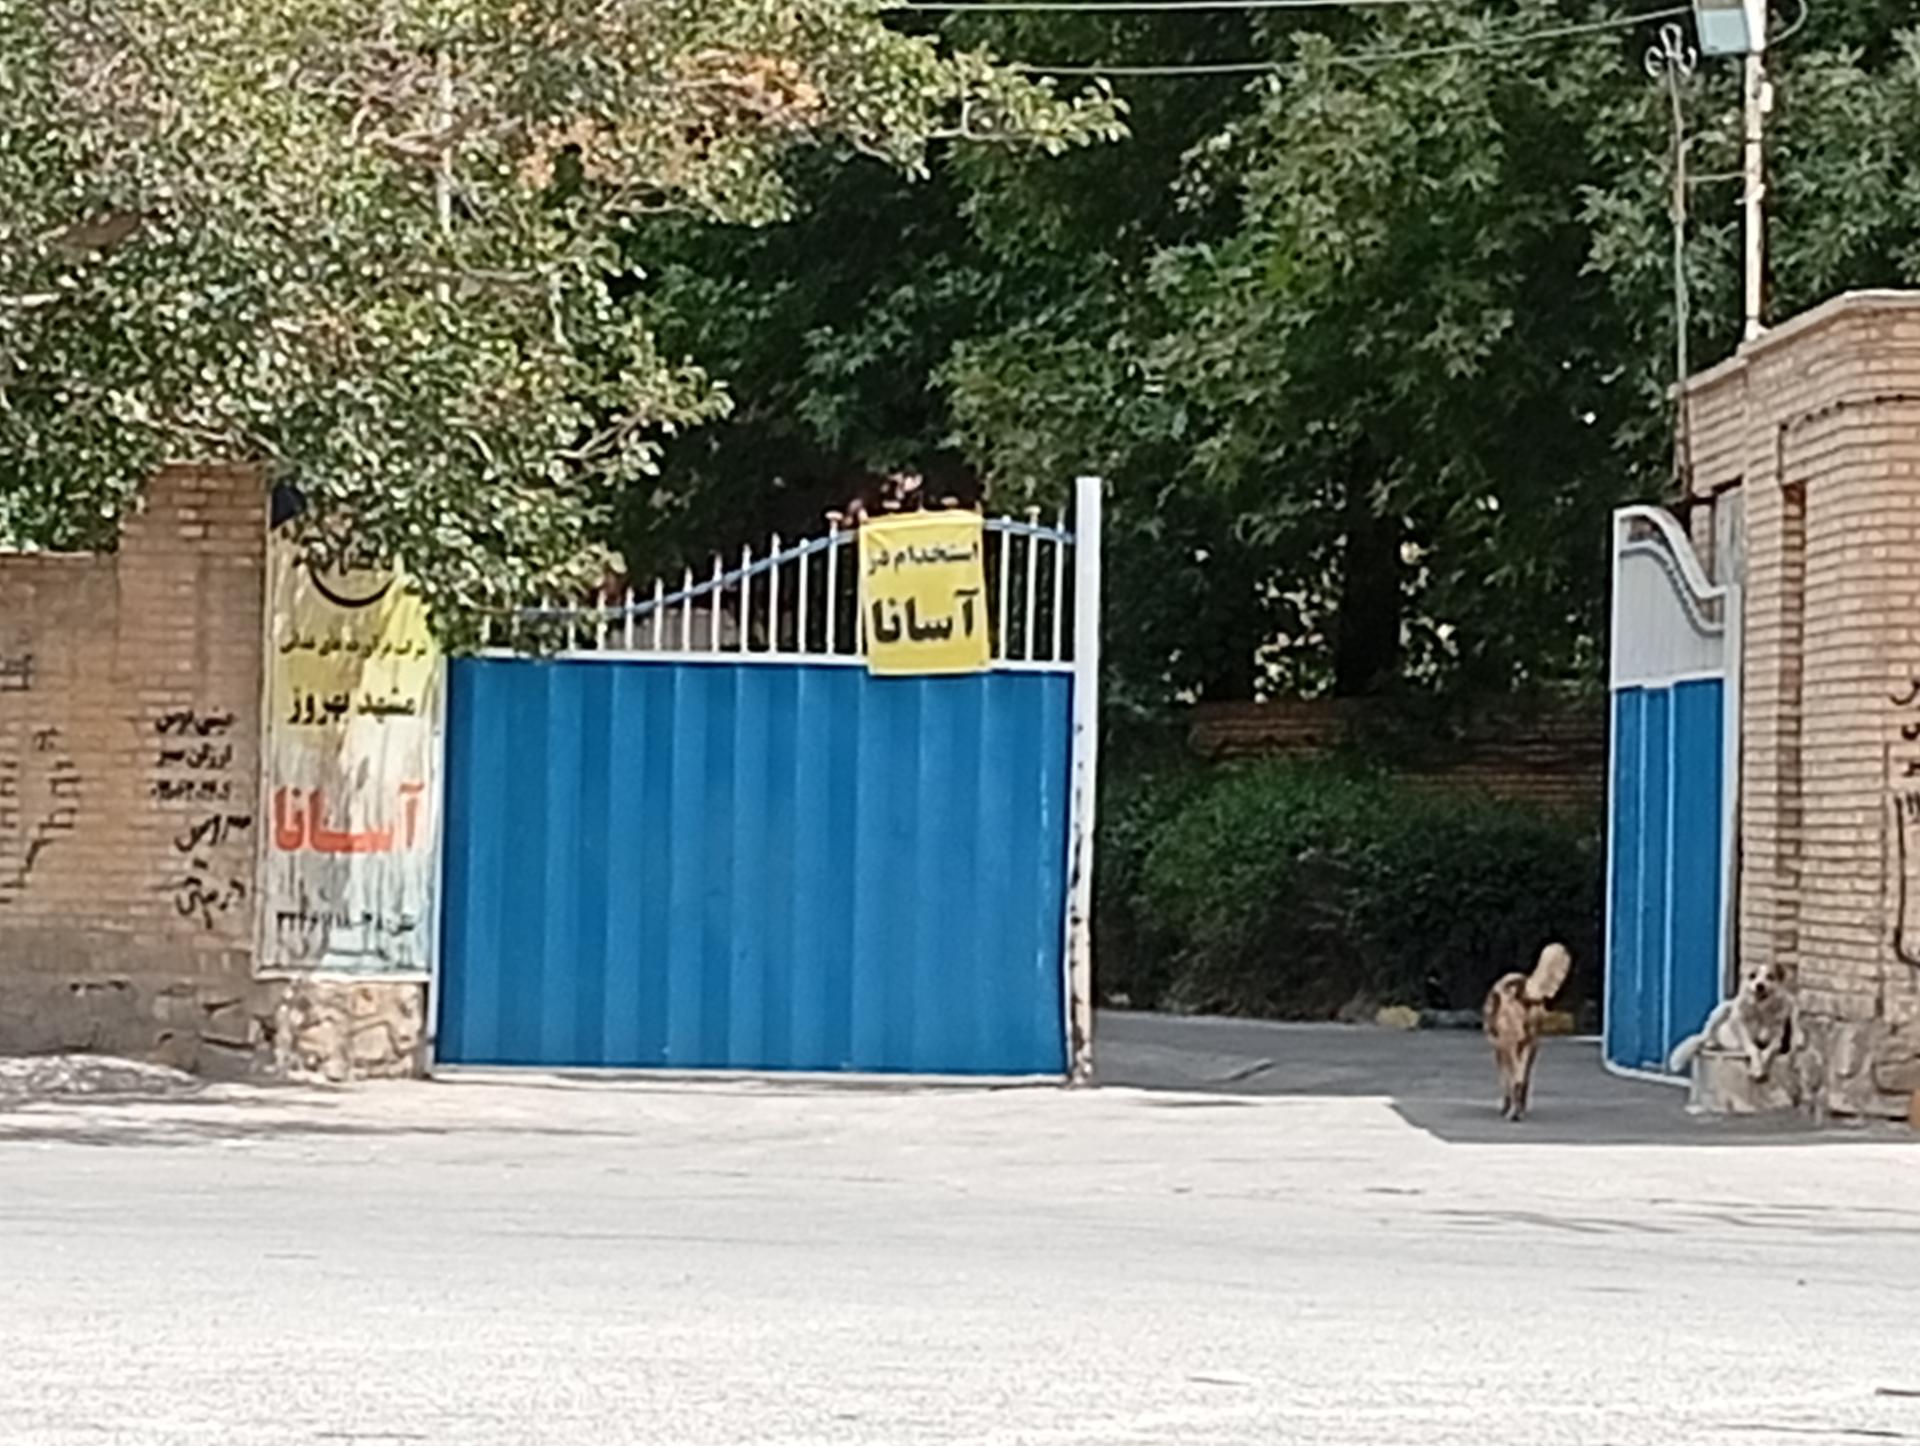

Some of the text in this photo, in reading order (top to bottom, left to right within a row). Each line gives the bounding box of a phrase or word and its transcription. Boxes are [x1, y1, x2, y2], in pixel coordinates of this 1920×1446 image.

[868, 541, 978, 576] استخدام در
[872, 588, 980, 643] آسانا
[287, 686, 350, 725] بهروز
[275, 782, 424, 853] آسانا
